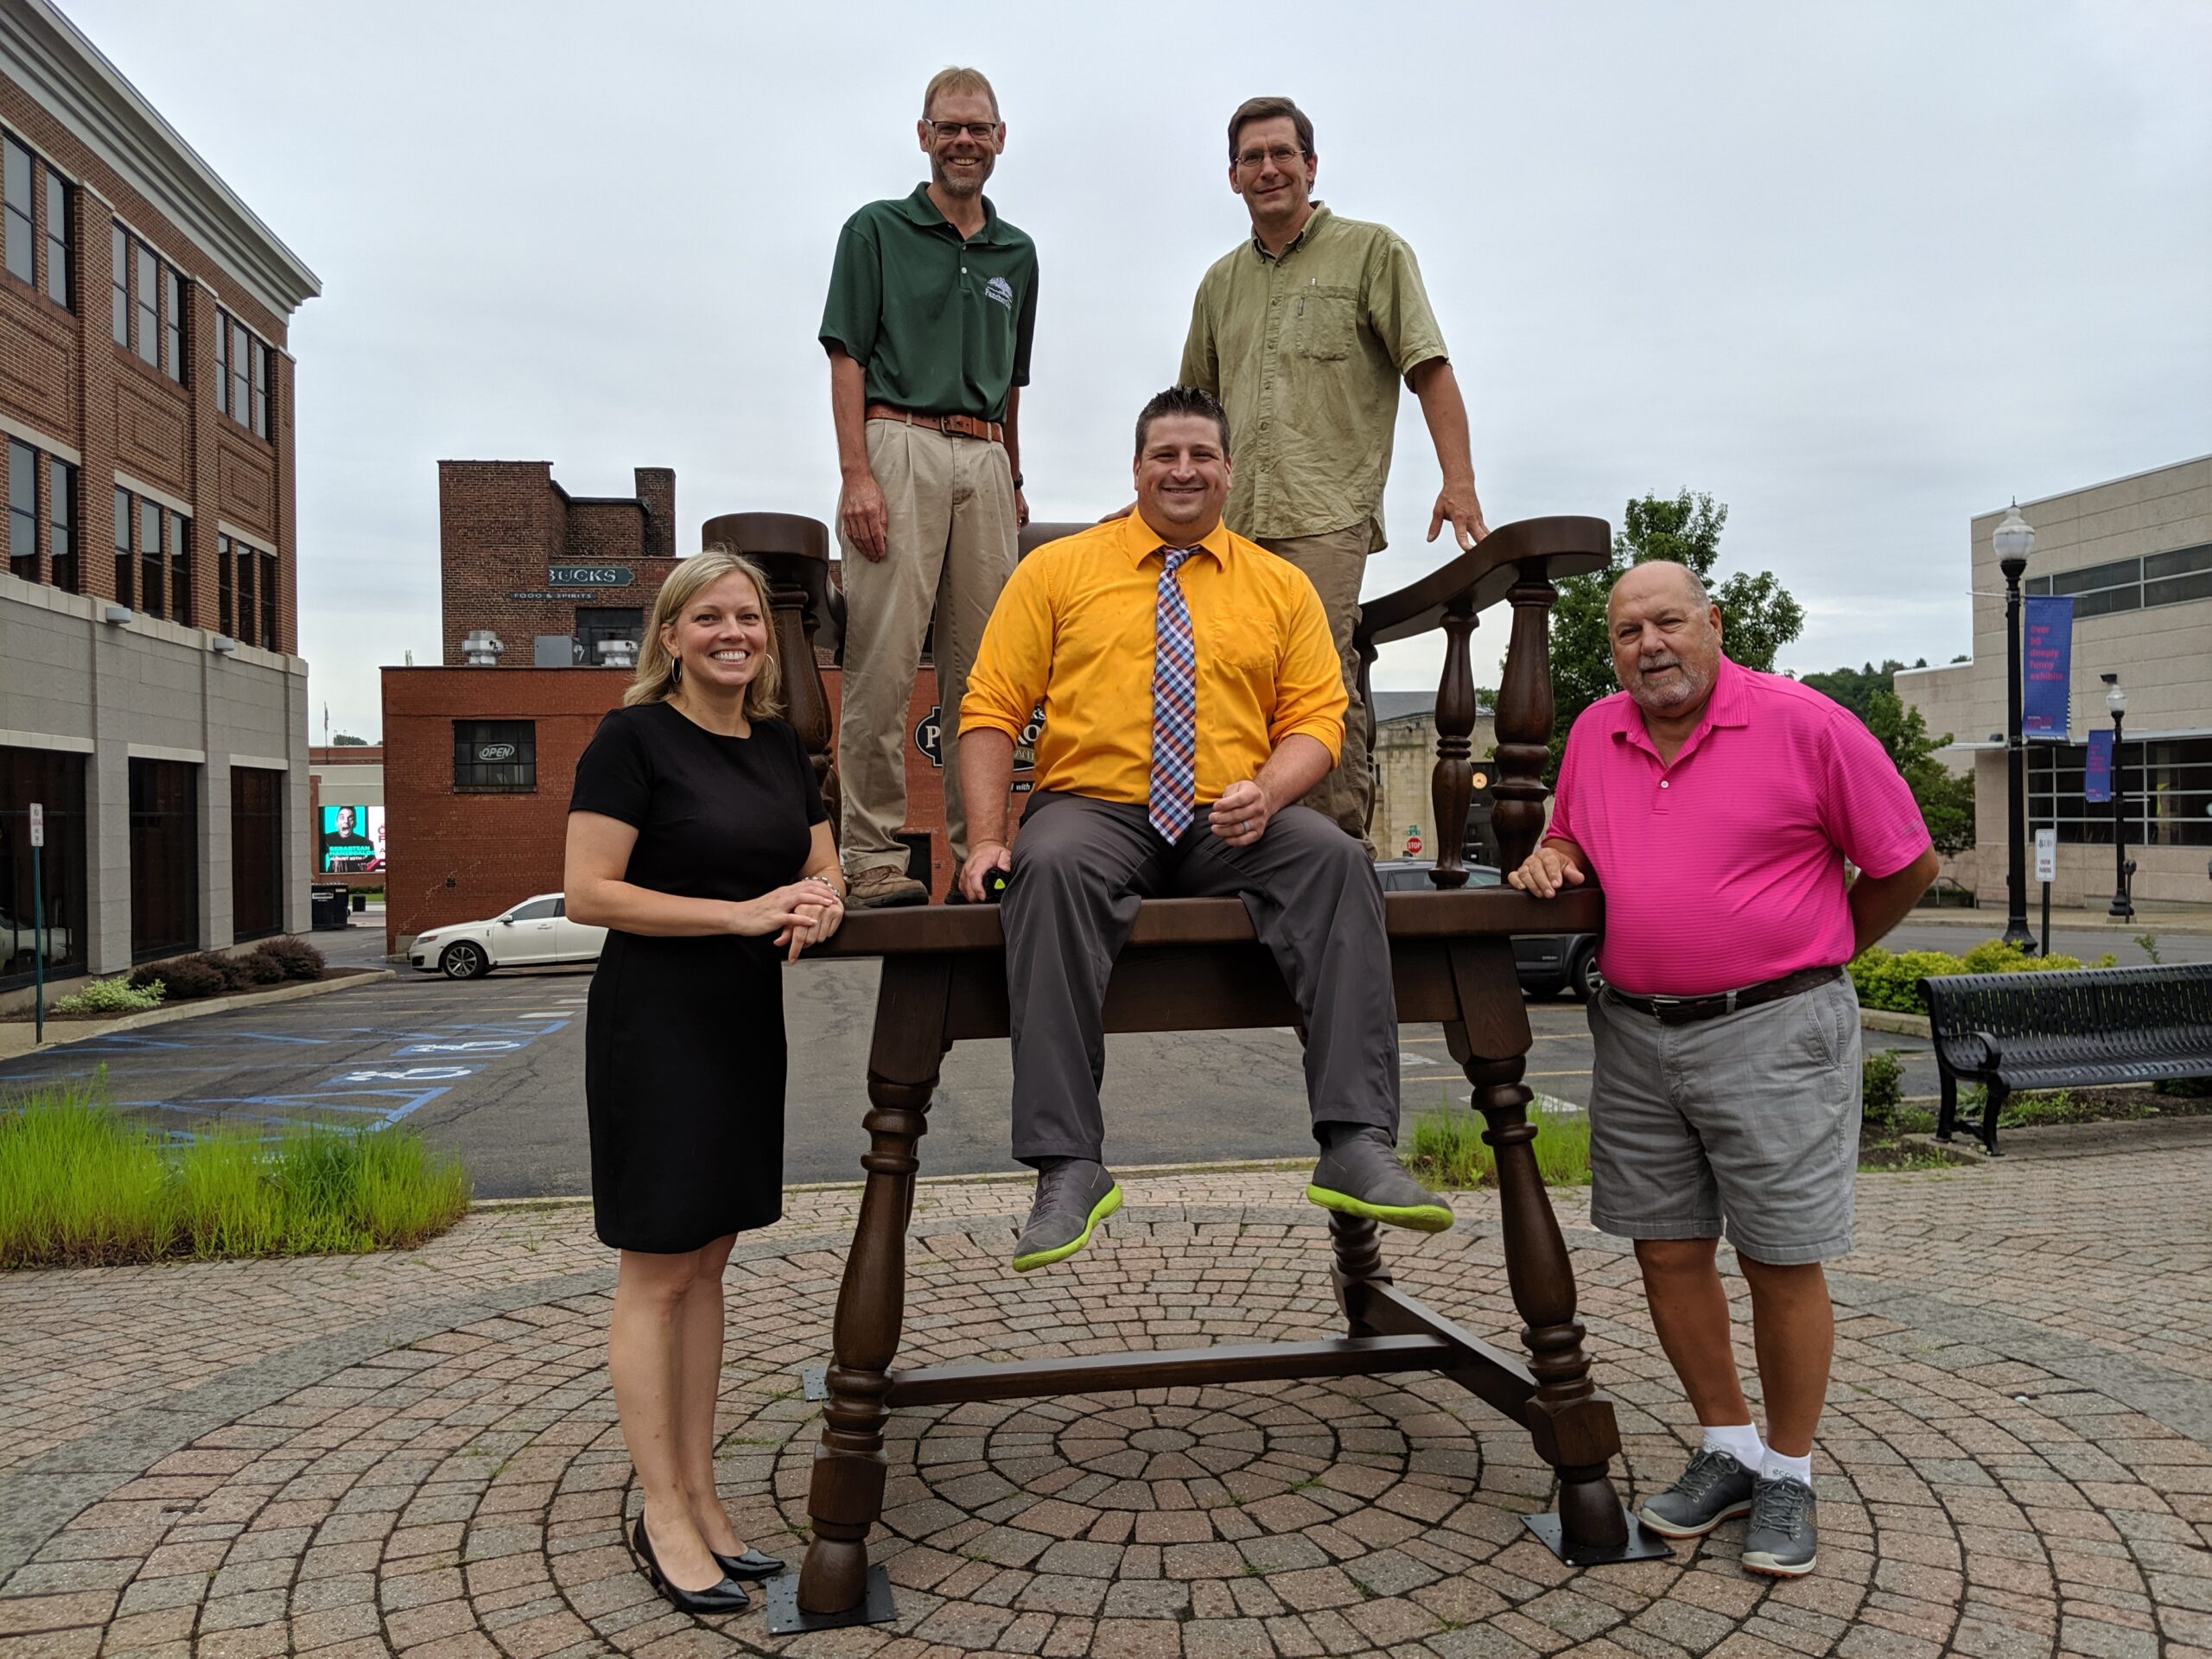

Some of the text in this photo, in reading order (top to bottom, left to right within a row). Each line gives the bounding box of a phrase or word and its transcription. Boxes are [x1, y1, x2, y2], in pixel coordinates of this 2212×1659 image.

[2030, 649, 2059, 659] deeply
[2030, 661, 2055, 671] funny
[481, 747, 512, 758] OPEN
[1016, 782, 1031, 791] with
